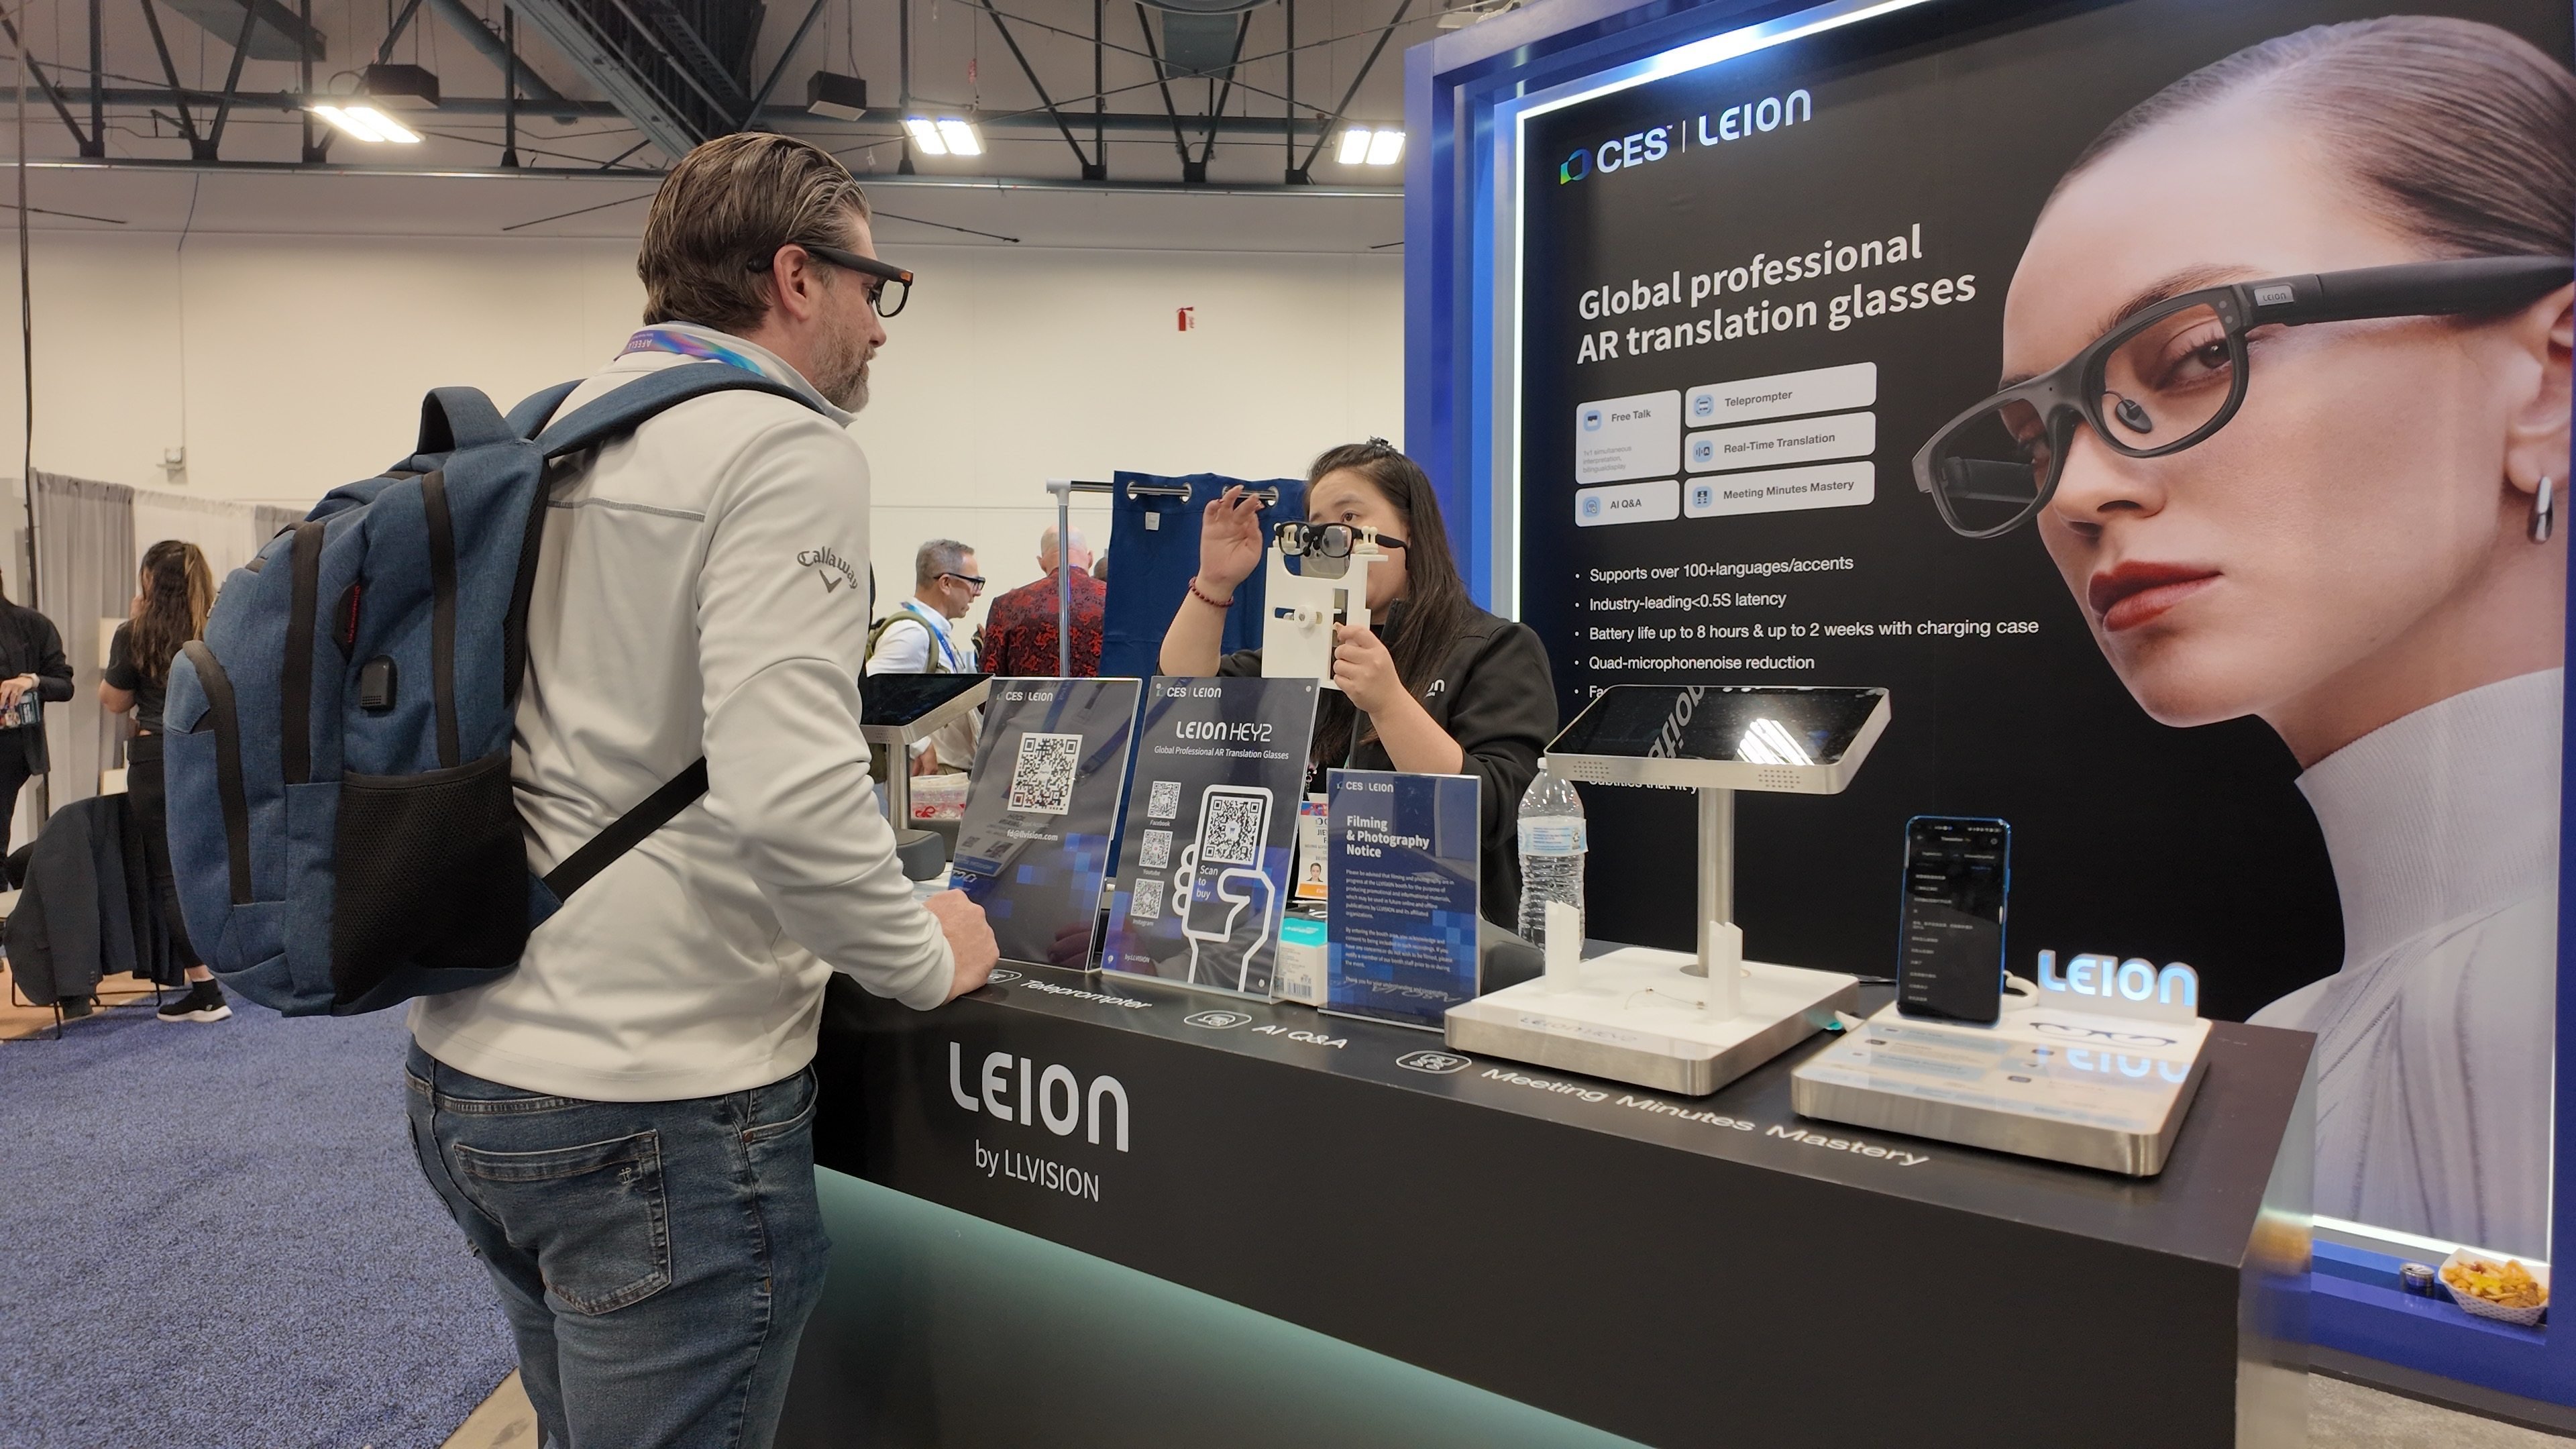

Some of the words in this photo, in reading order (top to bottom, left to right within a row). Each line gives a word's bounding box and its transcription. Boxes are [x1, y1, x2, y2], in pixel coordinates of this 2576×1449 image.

[1699, 89, 1811, 147] LEION
[1578, 270, 1681, 320] Global
[1690, 223, 1923, 312] professional
[1576, 329, 1619, 364] AR
[1627, 295, 1818, 356] translation
[1829, 274, 1976, 331] glasses
[1725, 390, 1792, 407] Teleprompter
[1611, 413, 1631, 422] Free
[1633, 409, 1652, 419] Talk
[1724, 439, 1774, 454] Real-Time
[1776, 433, 1836, 449] Translation
[1723, 487, 1764, 500] Meeting
[1766, 483, 1807, 496] Minutes
[1810, 480, 1854, 494] Mastery
[1610, 500, 1620, 509] AI
[1621, 498, 1642, 509] Q&A
[797, 546, 858, 590] Callaway
[1589, 568, 1648, 584] Supports
[1650, 566, 1679, 579] over
[1683, 556, 1854, 579] 100+languages/accents
[1589, 593, 1731, 612] Industry-leading<0.5S
[1735, 592, 1786, 609] latency
[1589, 626, 1634, 643] Battery
[1638, 625, 1656, 639] life
[1660, 628, 1676, 642] up
[1679, 626, 1693, 639] to
[1697, 625, 1706, 638] 8
[1709, 624, 1749, 638] hours
[1753, 624, 1764, 638] &
[1768, 625, 1786, 640] up
[1790, 624, 1806, 637] to
[1809, 623, 1820, 637] 2
[1824, 621, 1874, 636] weeks
[1879, 620, 1912, 635] with
[1917, 619, 1991, 638] charging
[1996, 621, 2039, 634] case
[1589, 655, 1741, 672] Quad-microphonenoise
[1746, 654, 1815, 669] reduction
[1006, 692, 1023, 701] CES
[1028, 692, 1053, 702] LEION
[1167, 687, 1187, 698] CES
[1193, 688, 1222, 698] LEION
[1176, 721, 1227, 740] LEION
[1230, 722, 1273, 742] HEY2
[1155, 746, 1175, 754] Global
[1175, 747, 1214, 756] Professional
[1226, 749, 1262, 758] Translation
[1263, 750, 1289, 759] Glasses
[1346, 782, 1363, 790] CES
[1368, 783, 1394, 792] LEION
[1347, 815, 1388, 832] Filming
[1346, 830, 1355, 841] &
[1357, 830, 1430, 850] Photography
[1346, 844, 1382, 858] Notice
[1199, 865, 1218, 875] Scan
[1198, 877, 1206, 886] to
[1196, 890, 1211, 900] buy
[2040, 950, 2197, 1007] LEION
[1020, 979, 1152, 1010] Teleprompter
[1252, 1024, 1279, 1036] AI
[1288, 1030, 1348, 1049] Q&A
[949, 1041, 1129, 1152] LEION
[1481, 1067, 1609, 1102] Meeting
[1615, 1094, 1756, 1132] Minutes
[1766, 1124, 1930, 1167] Mastery
[975, 1139, 998, 1177] by
[1006, 1148, 1099, 1202] LLVISION
